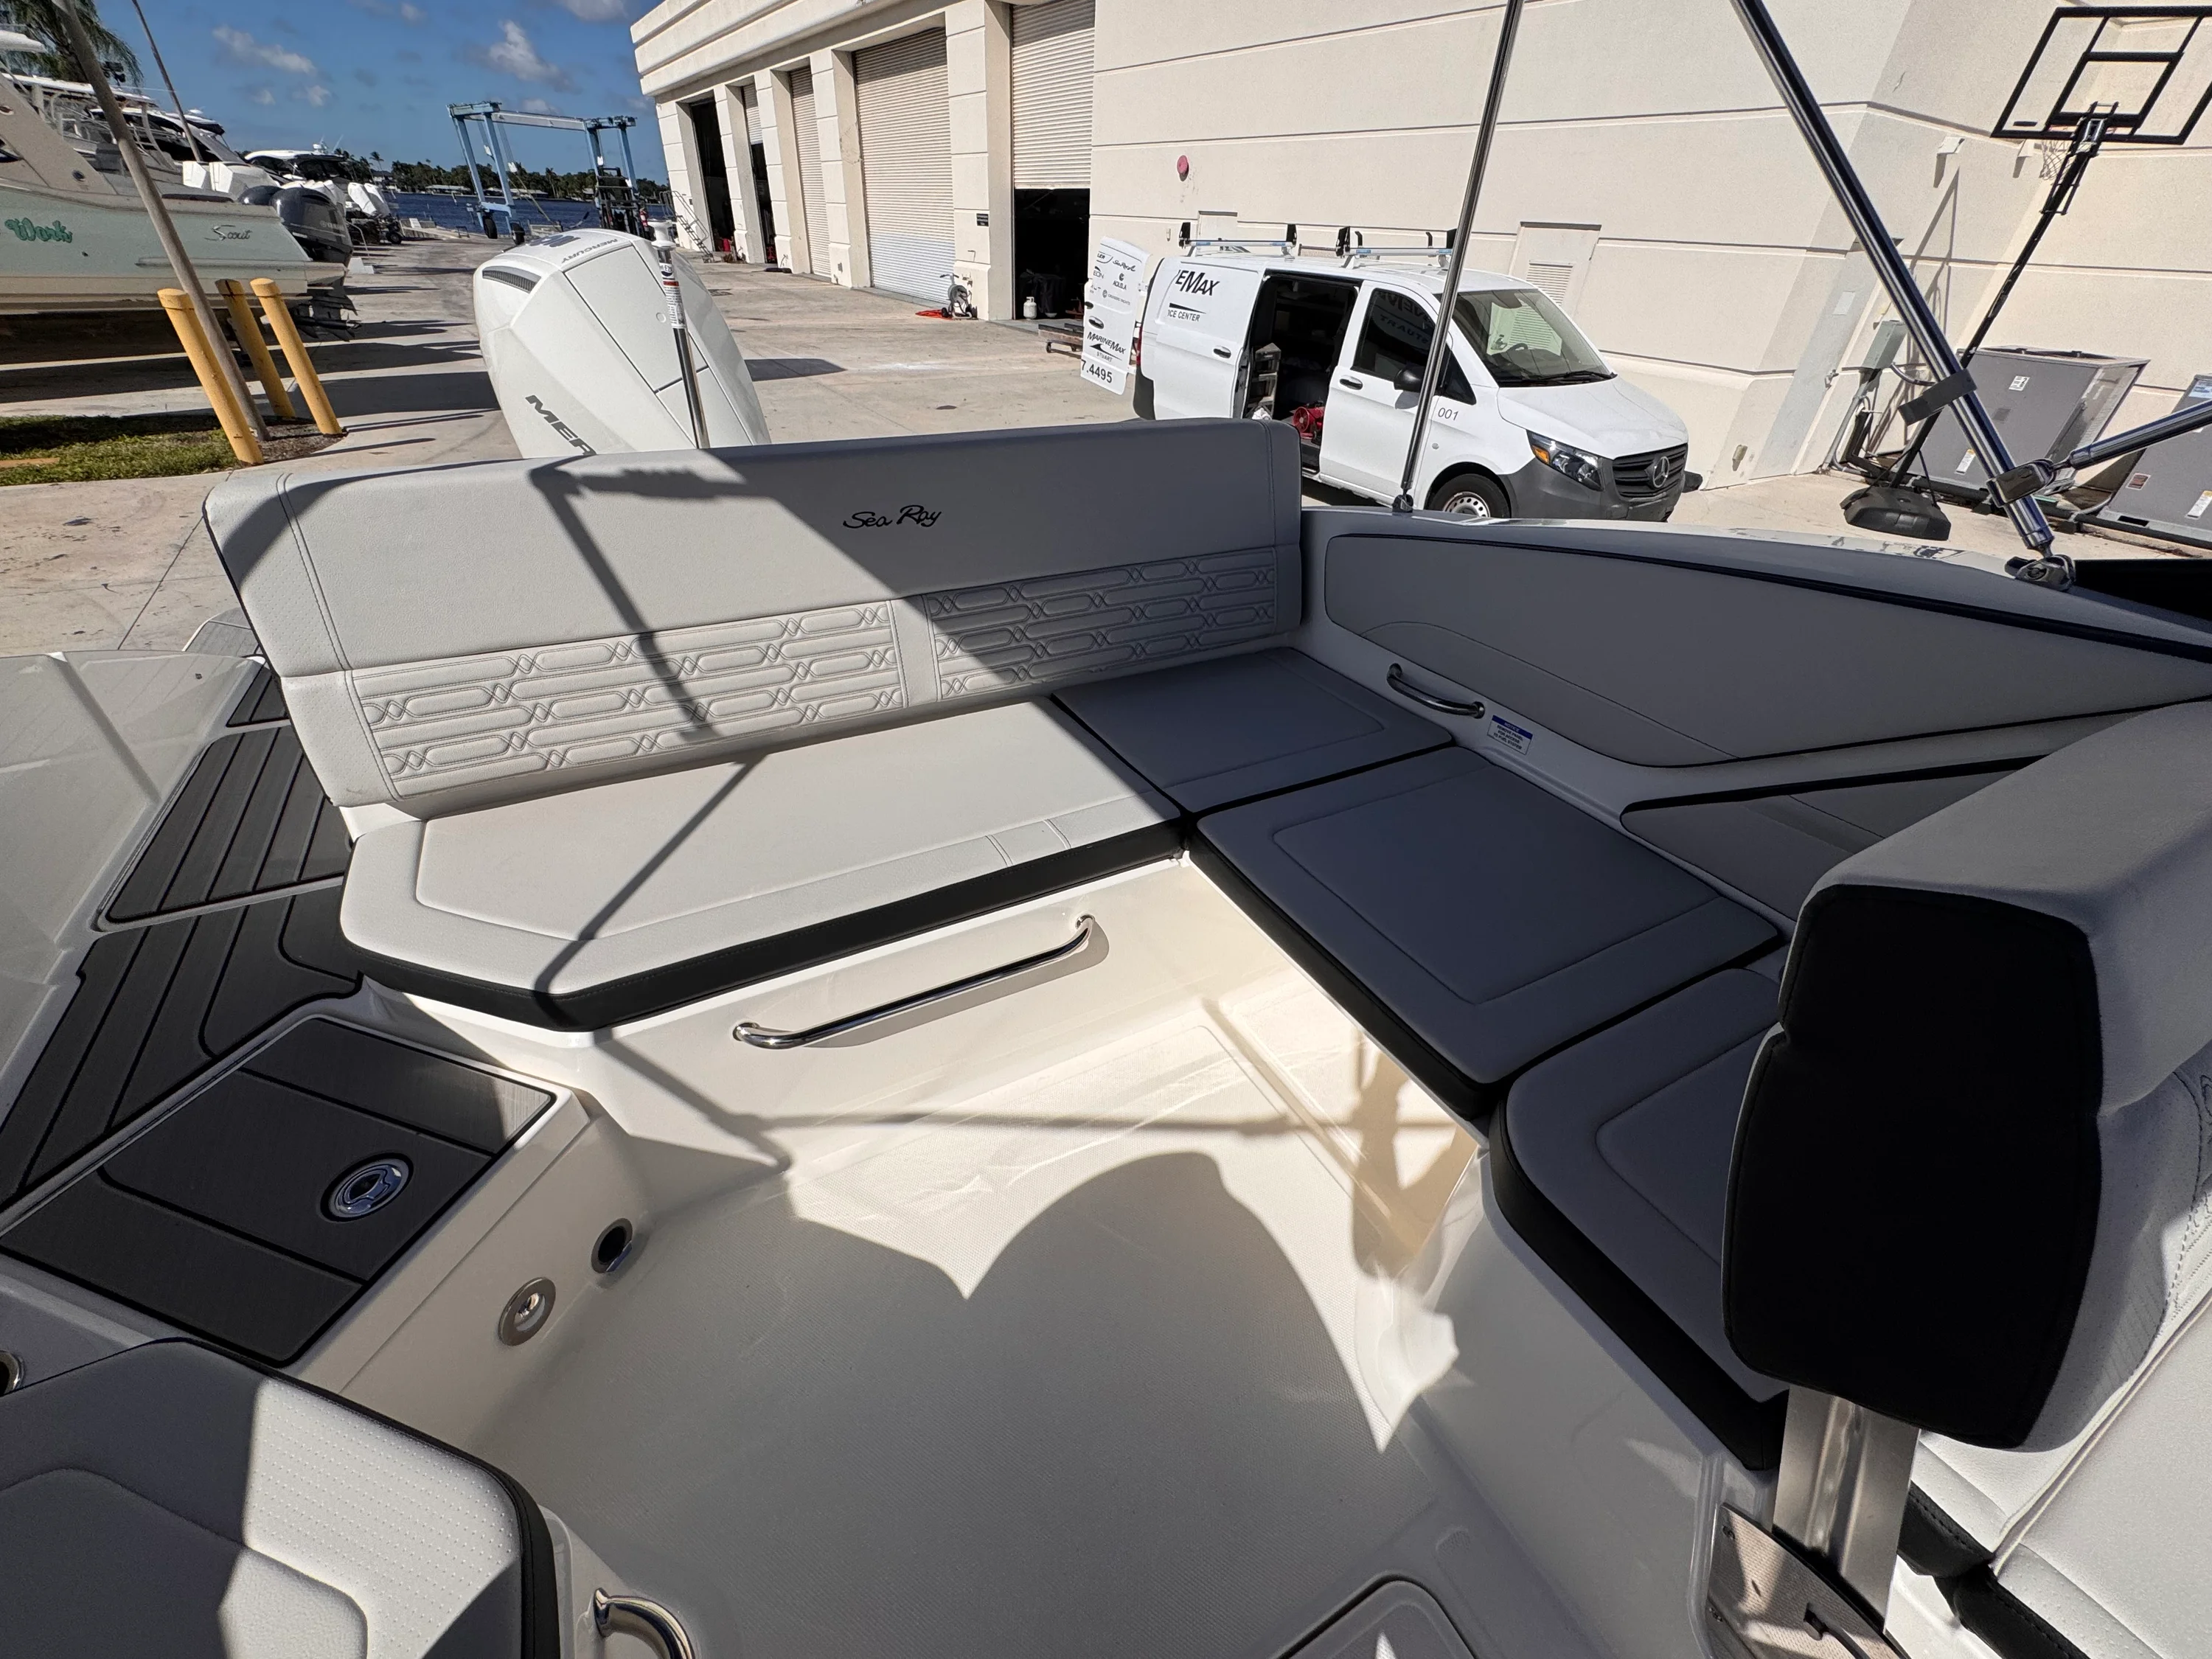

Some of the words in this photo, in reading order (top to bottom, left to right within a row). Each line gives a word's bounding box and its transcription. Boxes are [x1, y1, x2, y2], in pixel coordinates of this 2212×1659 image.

[4, 218, 73, 243] Work
[204, 224, 252, 241] Scout
[561, 238, 618, 263] MERCURY
[1178, 311, 1200, 321] CENTER
[1096, 352, 1113, 362] STUART
[1438, 408, 1458, 420] 001
[843, 511, 892, 529] Sea
[896, 504, 942, 527] Ray
[1504, 722, 1520, 733] NOTICE
